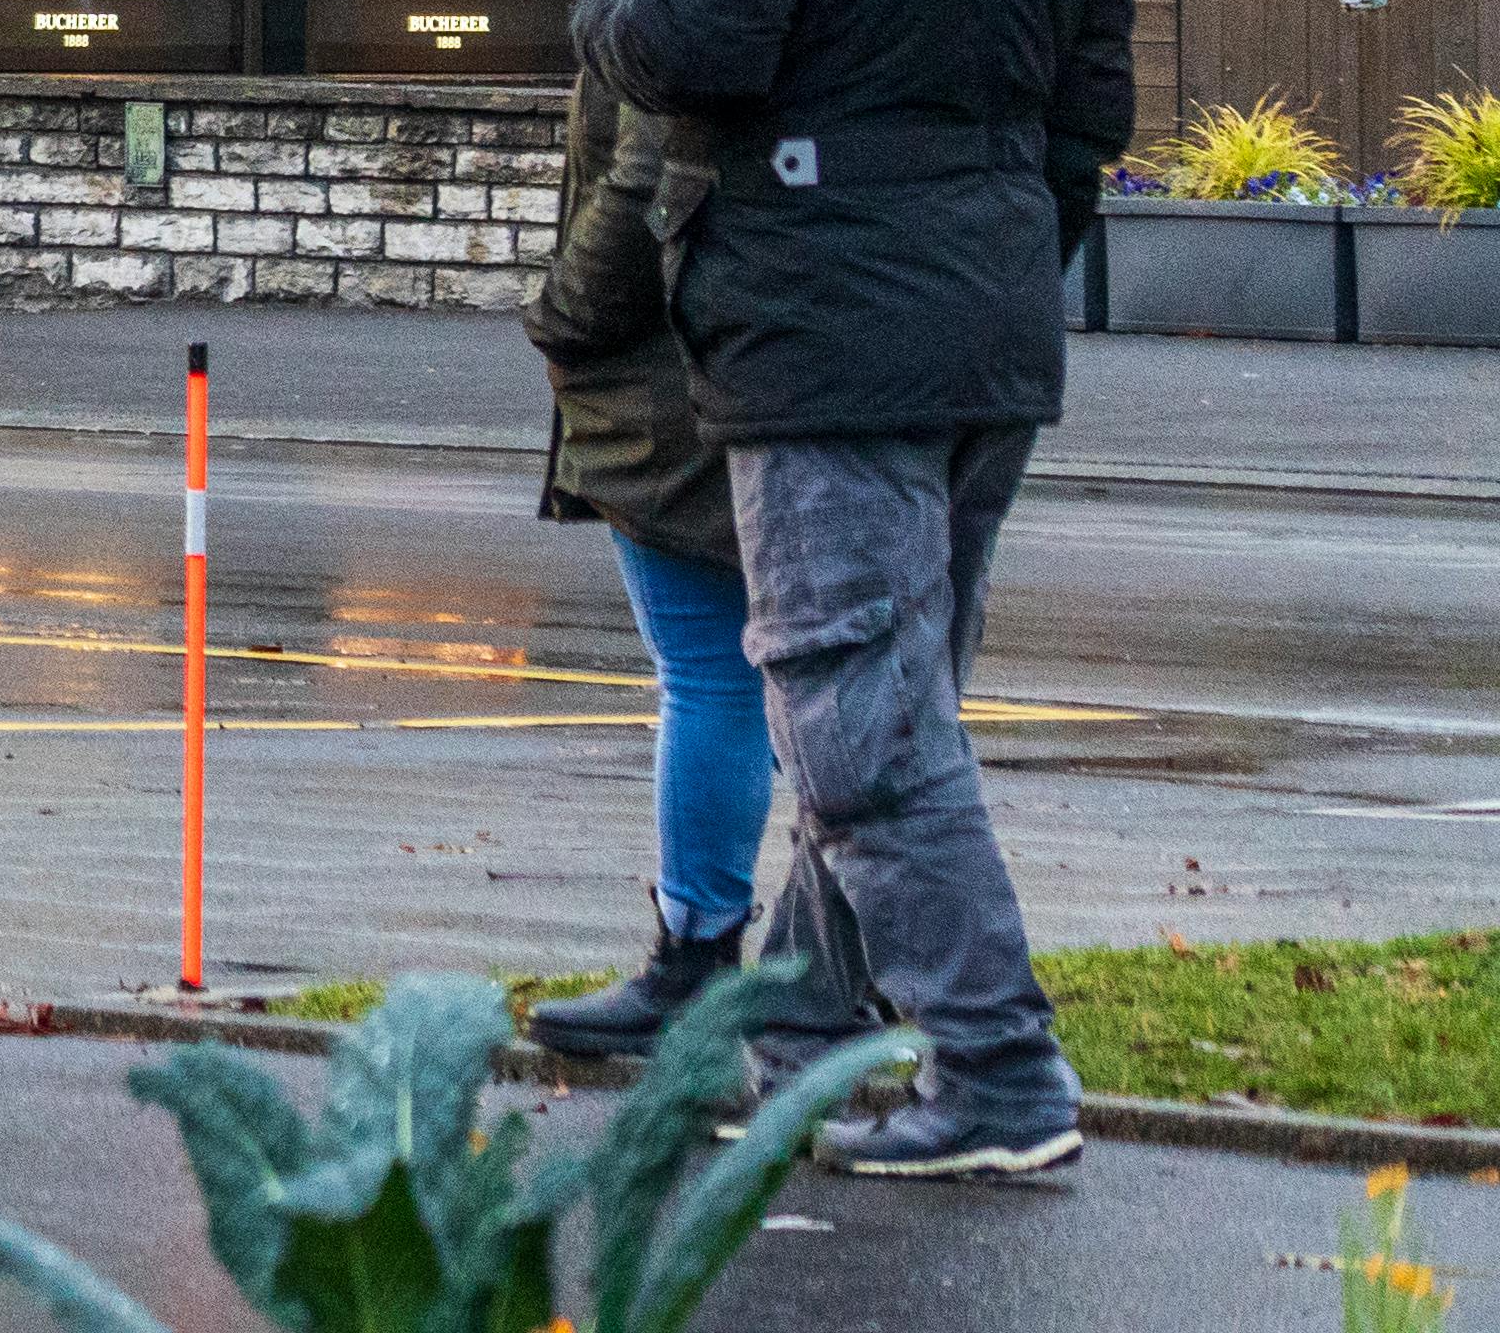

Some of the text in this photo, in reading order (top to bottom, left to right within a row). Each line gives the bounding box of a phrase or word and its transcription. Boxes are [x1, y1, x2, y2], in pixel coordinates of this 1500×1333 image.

[33, 12, 120, 31] BUCHERER
[407, 15, 491, 33] BUCHERER
[63, 34, 90, 48] 1888
[435, 35, 462, 49] 1888
